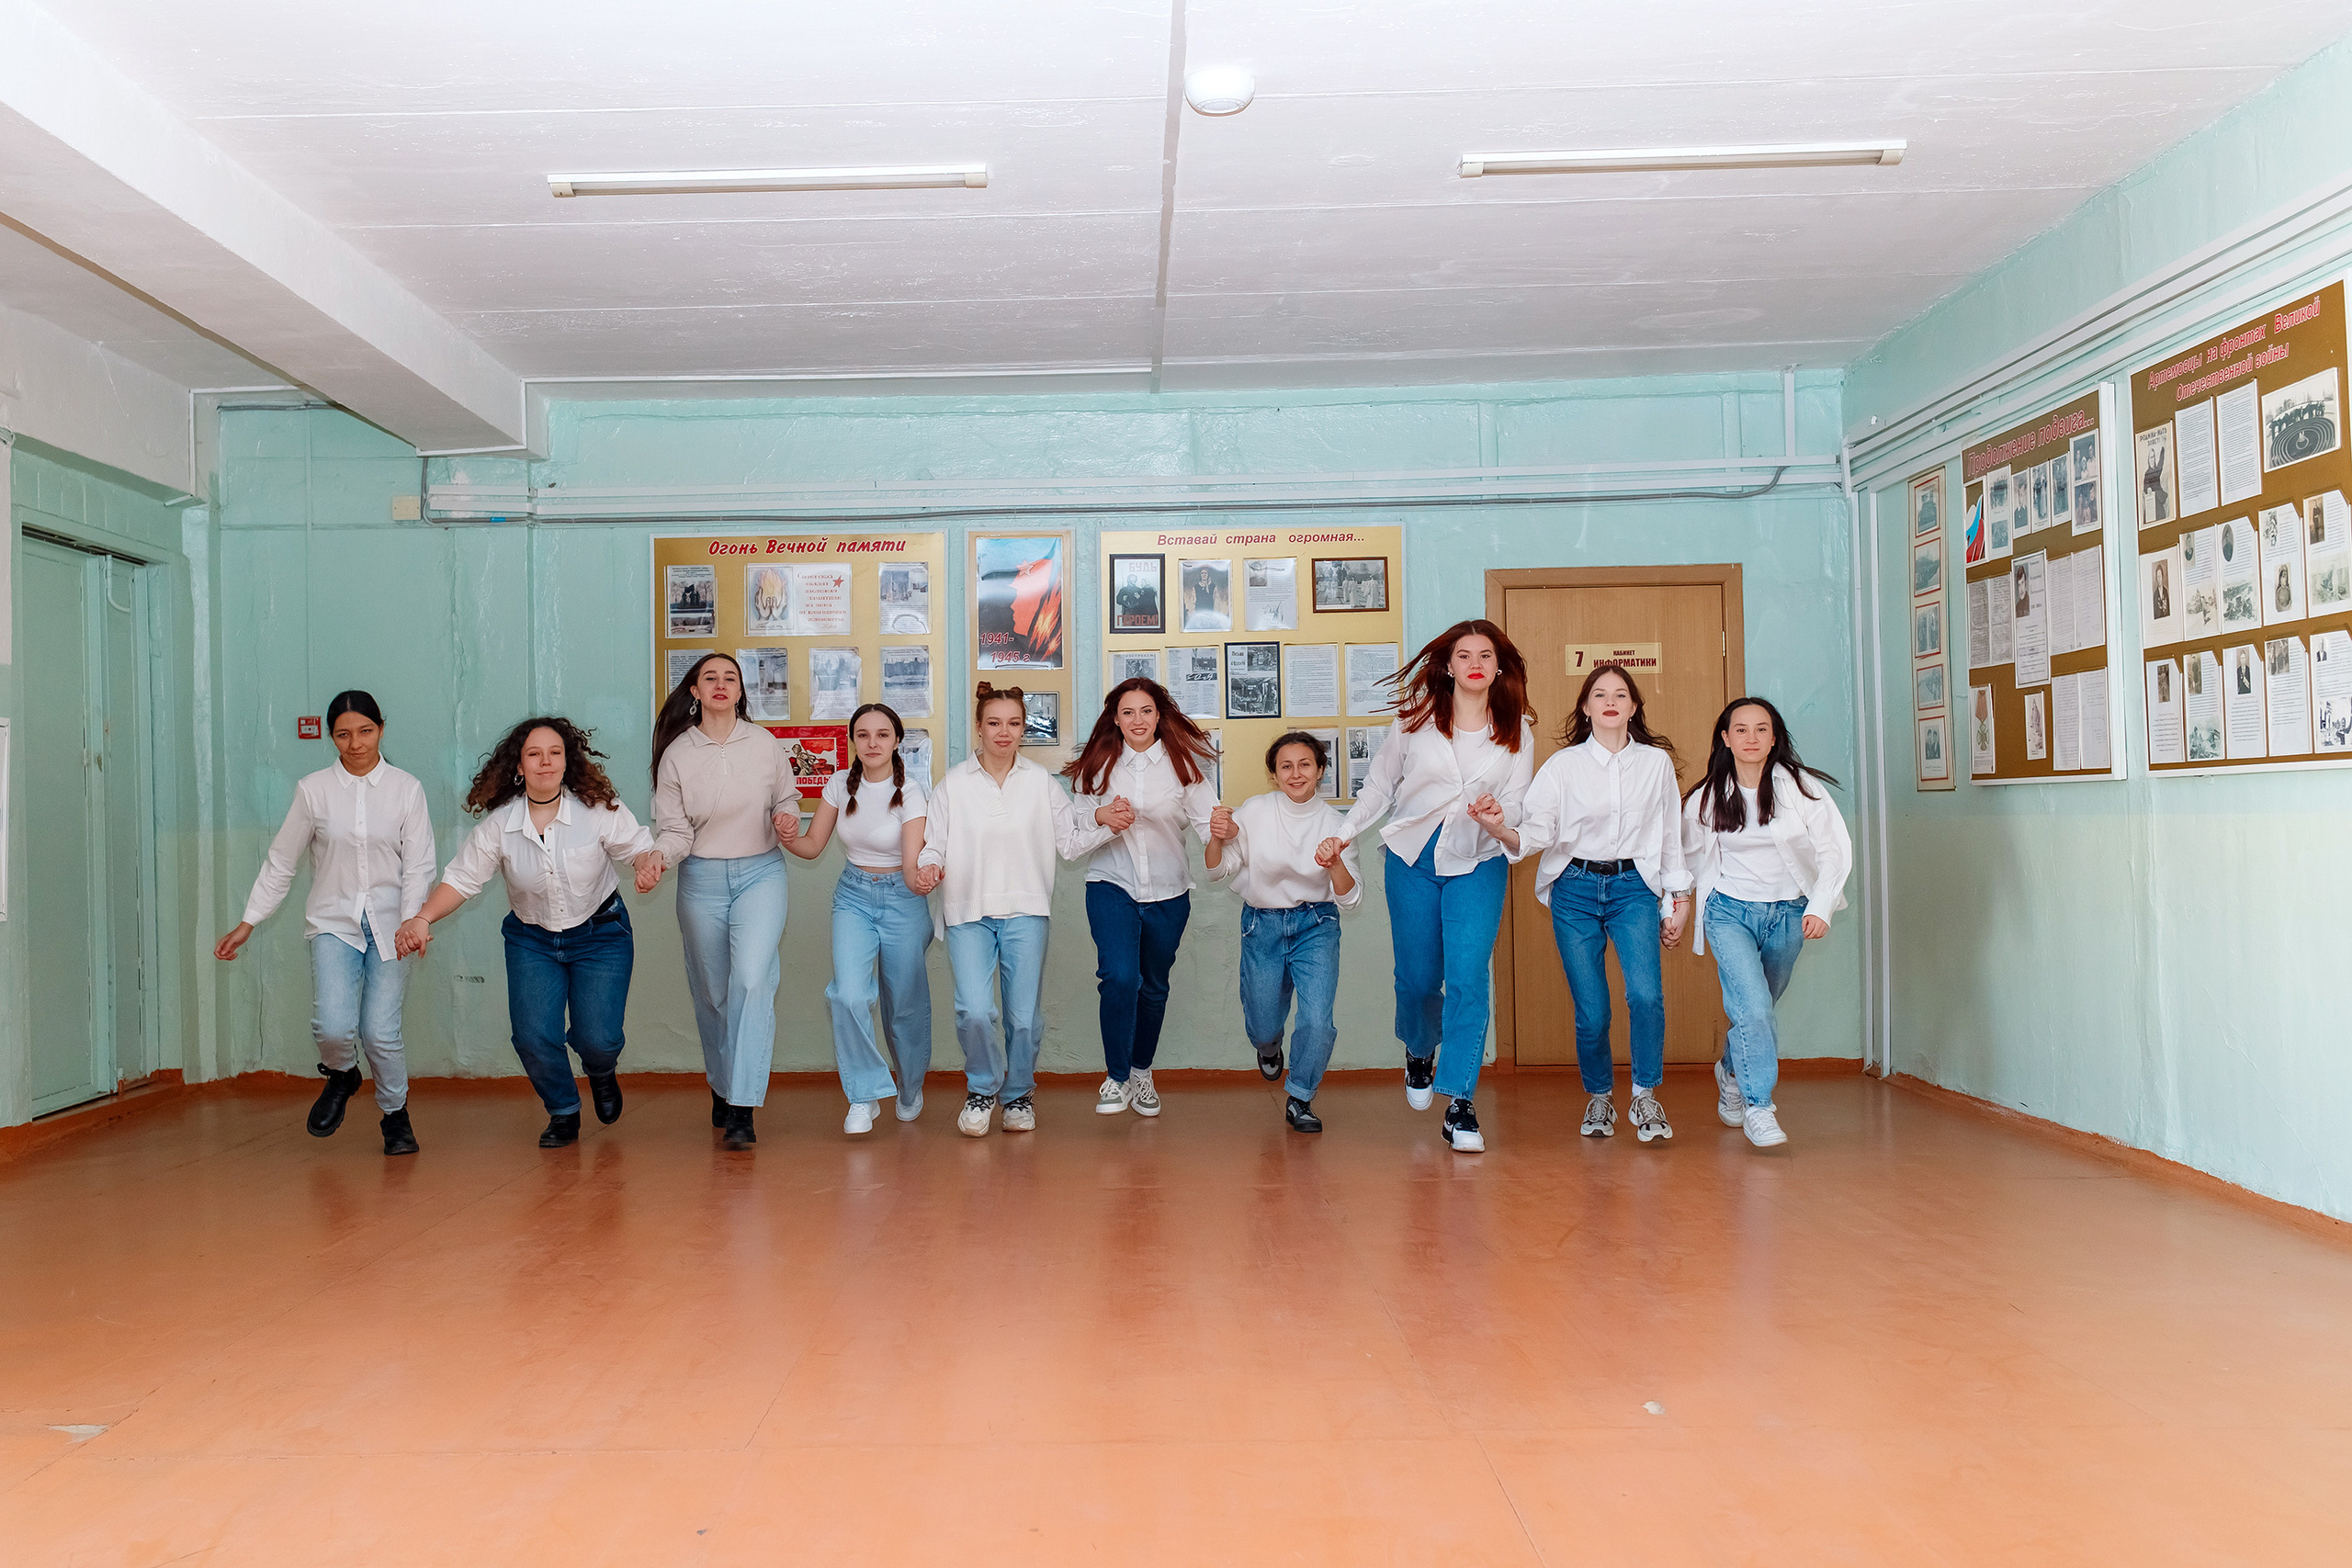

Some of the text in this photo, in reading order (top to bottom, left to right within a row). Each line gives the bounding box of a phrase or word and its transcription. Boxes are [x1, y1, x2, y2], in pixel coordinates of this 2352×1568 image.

[2148, 296, 2321, 391] Артемовцы на фронтах Великой
[2176, 342, 2290, 401] Отечественной войны
[1967, 431, 2037, 477] Продолжение
[1158, 533, 1364, 546] Вставай страна огромная...
[708, 537, 906, 556] Огонь Вечной памяти
[1129, 562, 1158, 572] БУДЬ
[1117, 615, 1159, 626] ГЕРОЕМ!
[979, 632, 1014, 645] 1941-
[991, 650, 1021, 662] 1945
[1575, 650, 1584, 668] 7
[1593, 658, 1657, 668] ИНФОРМАТИКИ
